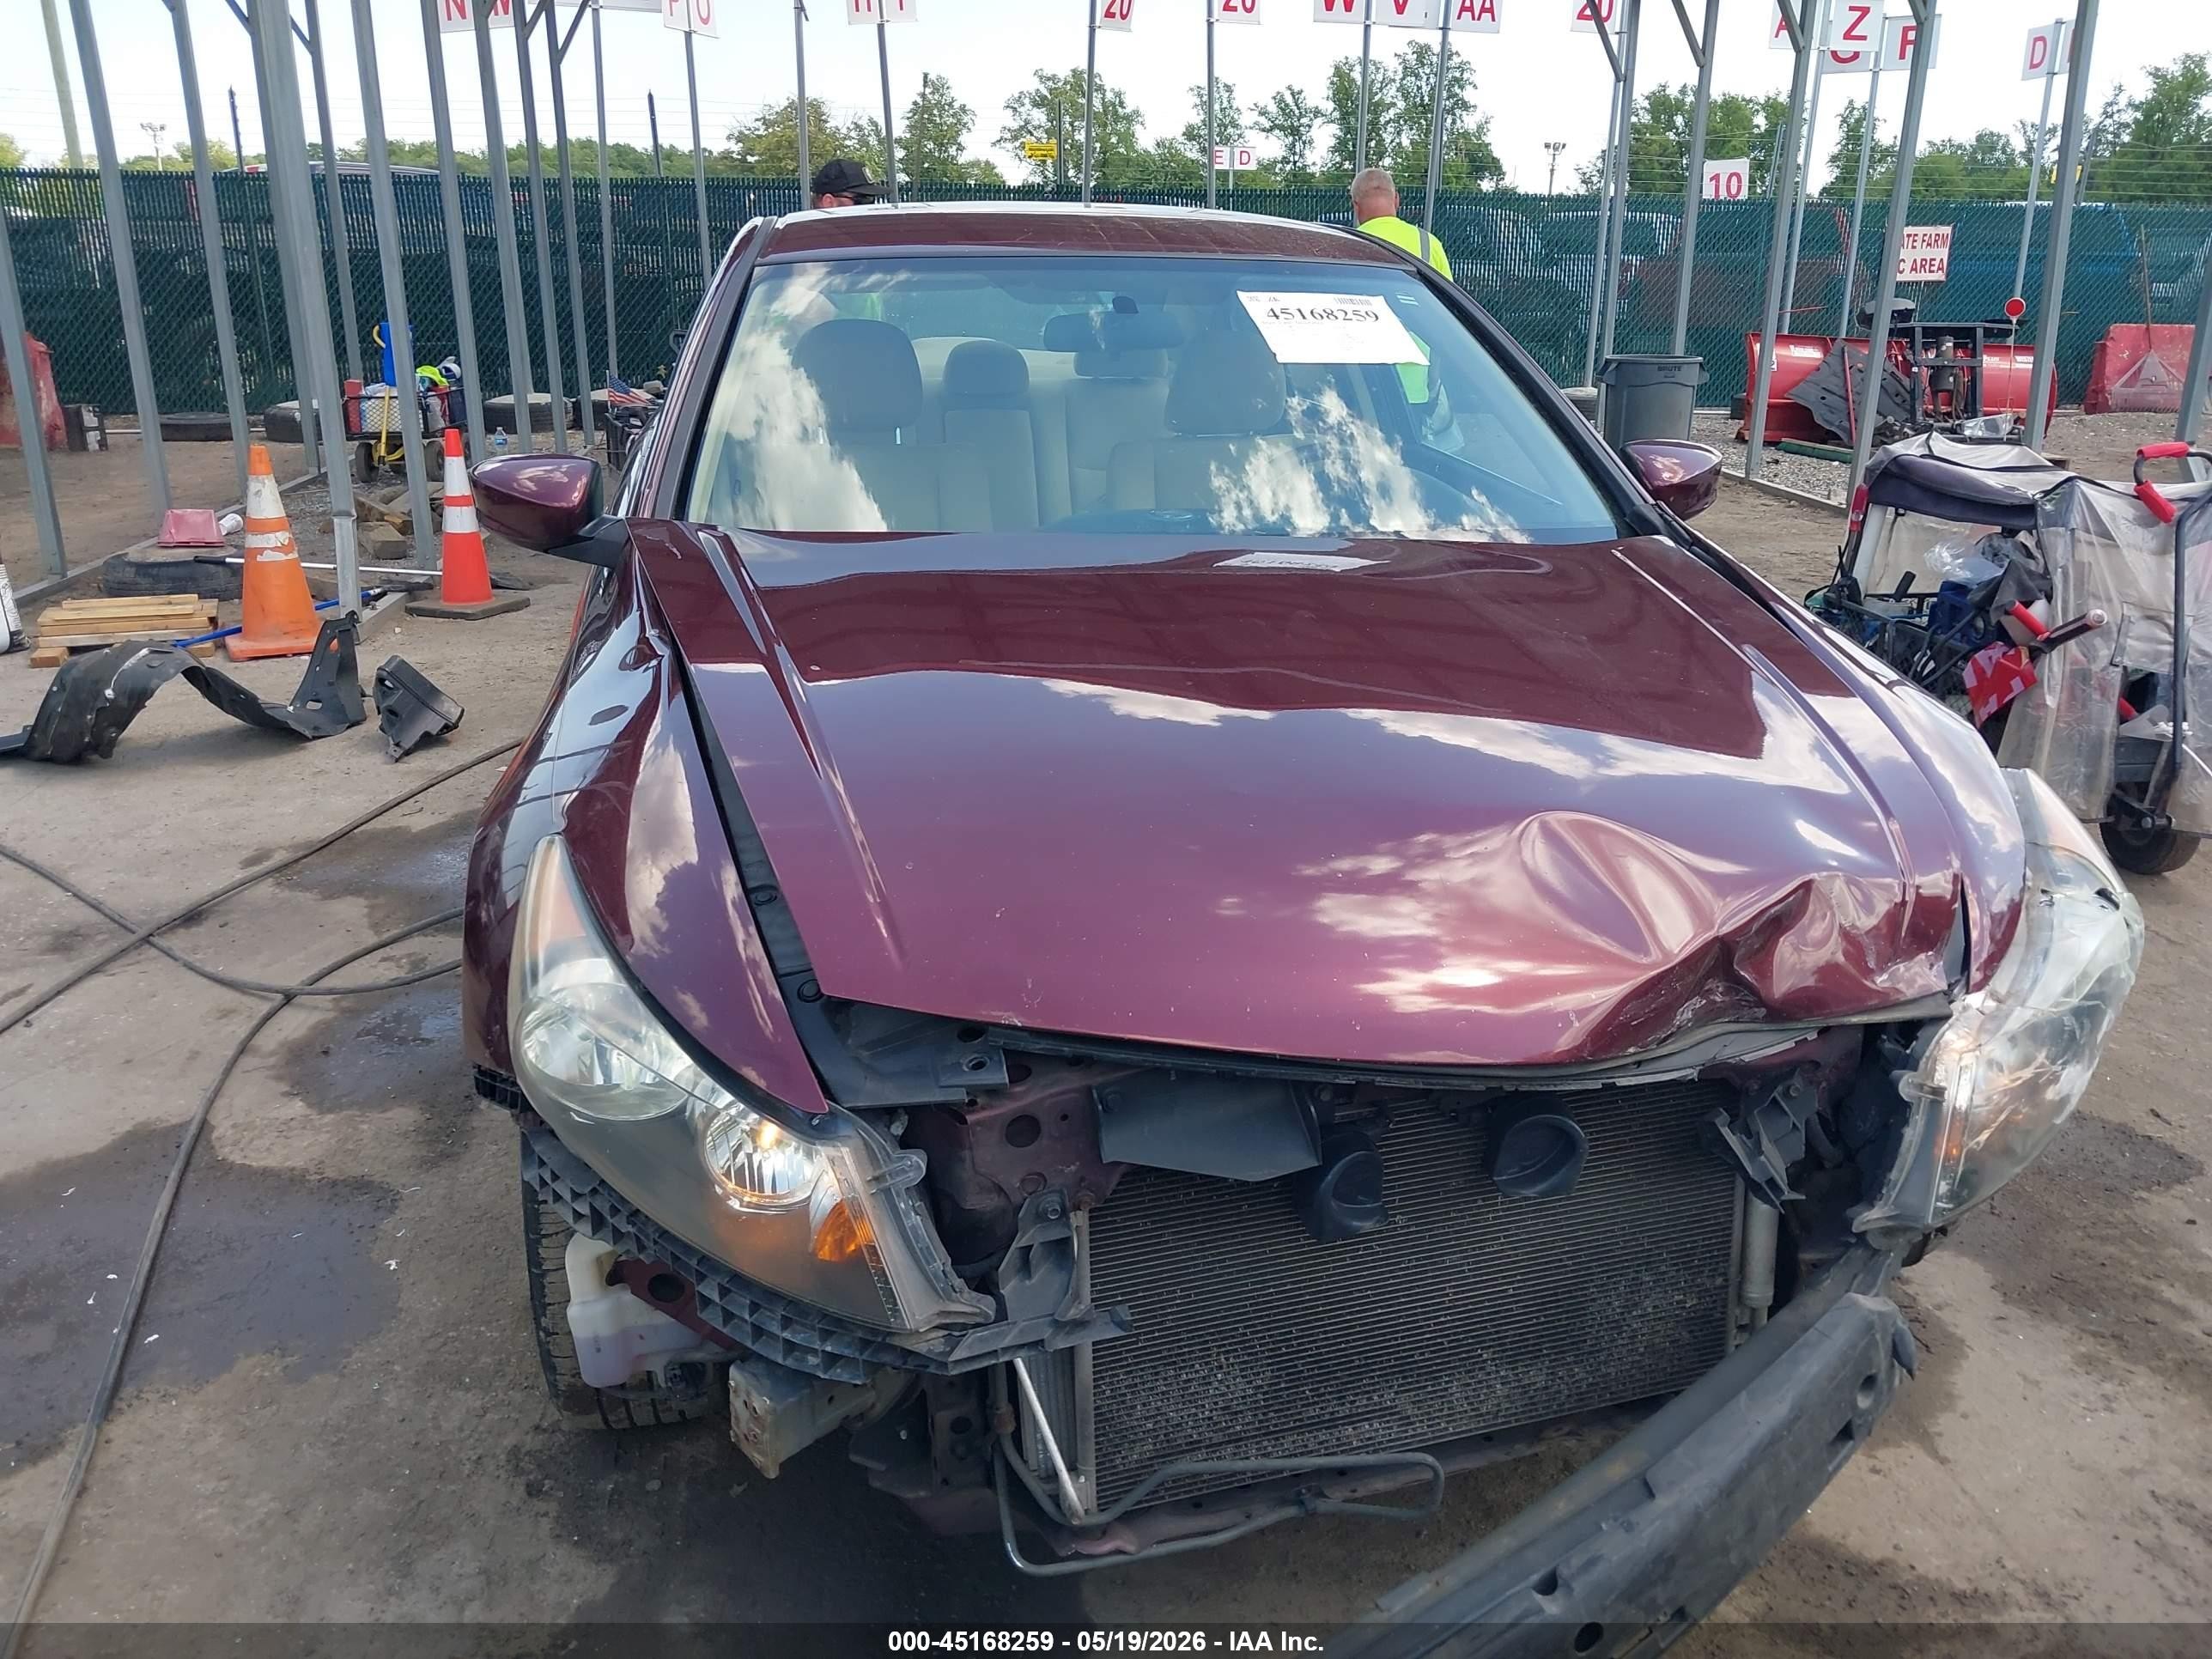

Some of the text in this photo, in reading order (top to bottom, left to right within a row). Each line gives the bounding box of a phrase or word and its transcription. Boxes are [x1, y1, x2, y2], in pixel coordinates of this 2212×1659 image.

[1842, 5, 1871, 41] Z
[2029, 35, 2048, 70] D
[1214, 149, 1224, 165] E
[1239, 150, 1251, 166] D
[1709, 171, 1743, 200] 10
[1921, 233, 1949, 249] FARM
[1909, 258, 1945, 275] AREA
[1267, 307, 1379, 323] 45168259
